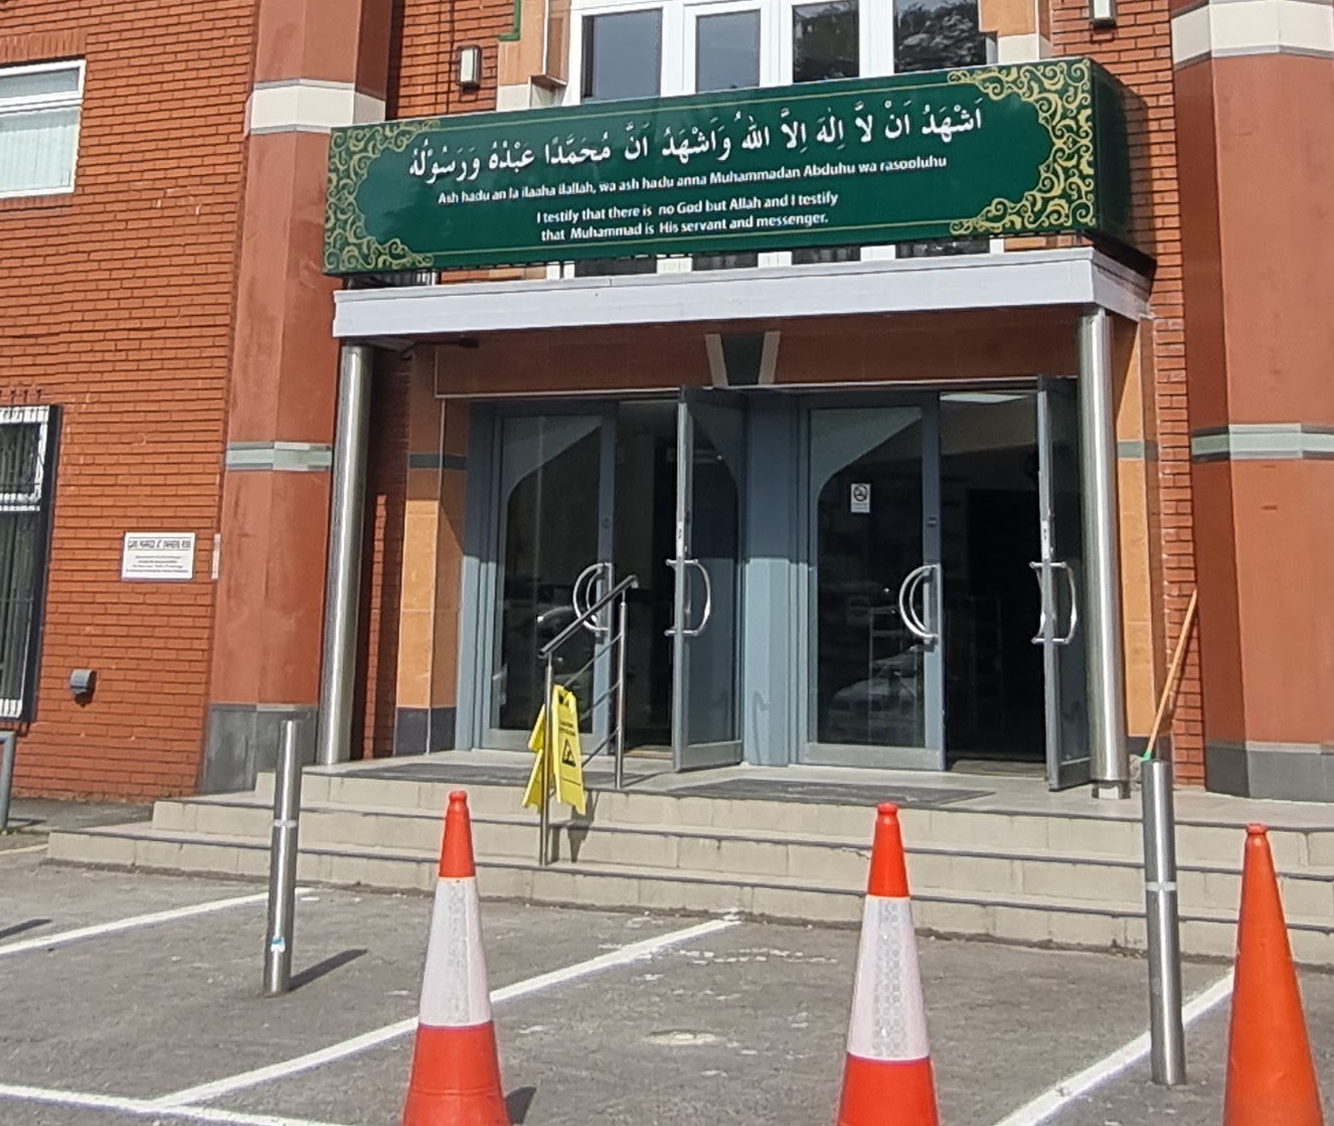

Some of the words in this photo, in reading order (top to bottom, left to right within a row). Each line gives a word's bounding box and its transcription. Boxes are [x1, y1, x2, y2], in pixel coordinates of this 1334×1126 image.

[438, 192, 458, 204] Ash
[461, 190, 490, 203] hadu
[492, 191, 506, 200] an
[522, 184, 556, 198] ilaaha
[599, 182, 616, 192] wa
[619, 178, 639, 191] ash
[642, 175, 674, 189] hadu
[676, 175, 707, 187] anna
[710, 166, 801, 185] Muhammadan
[803, 162, 856, 178] Abduhu
[858, 162, 877, 173] wa
[880, 155, 947, 172] rasooluhu
[543, 209, 579, 224] testify
[582, 207, 605, 220] that
[608, 206, 640, 219] there
[642, 204, 652, 216] is
[658, 204, 675, 216] no
[677, 199, 702, 214] God
[705, 199, 726, 212] but
[729, 196, 761, 210] Allah
[763, 194, 788, 208] and
[798, 191, 838, 206] testify
[541, 229, 565, 242] that
[570, 223, 642, 240] Muhammad
[645, 223, 654, 235] is
[659, 221, 679, 235] His
[681, 219, 727, 233] servant
[729, 215, 753, 229] and
[756, 212, 828, 228] messenger.
